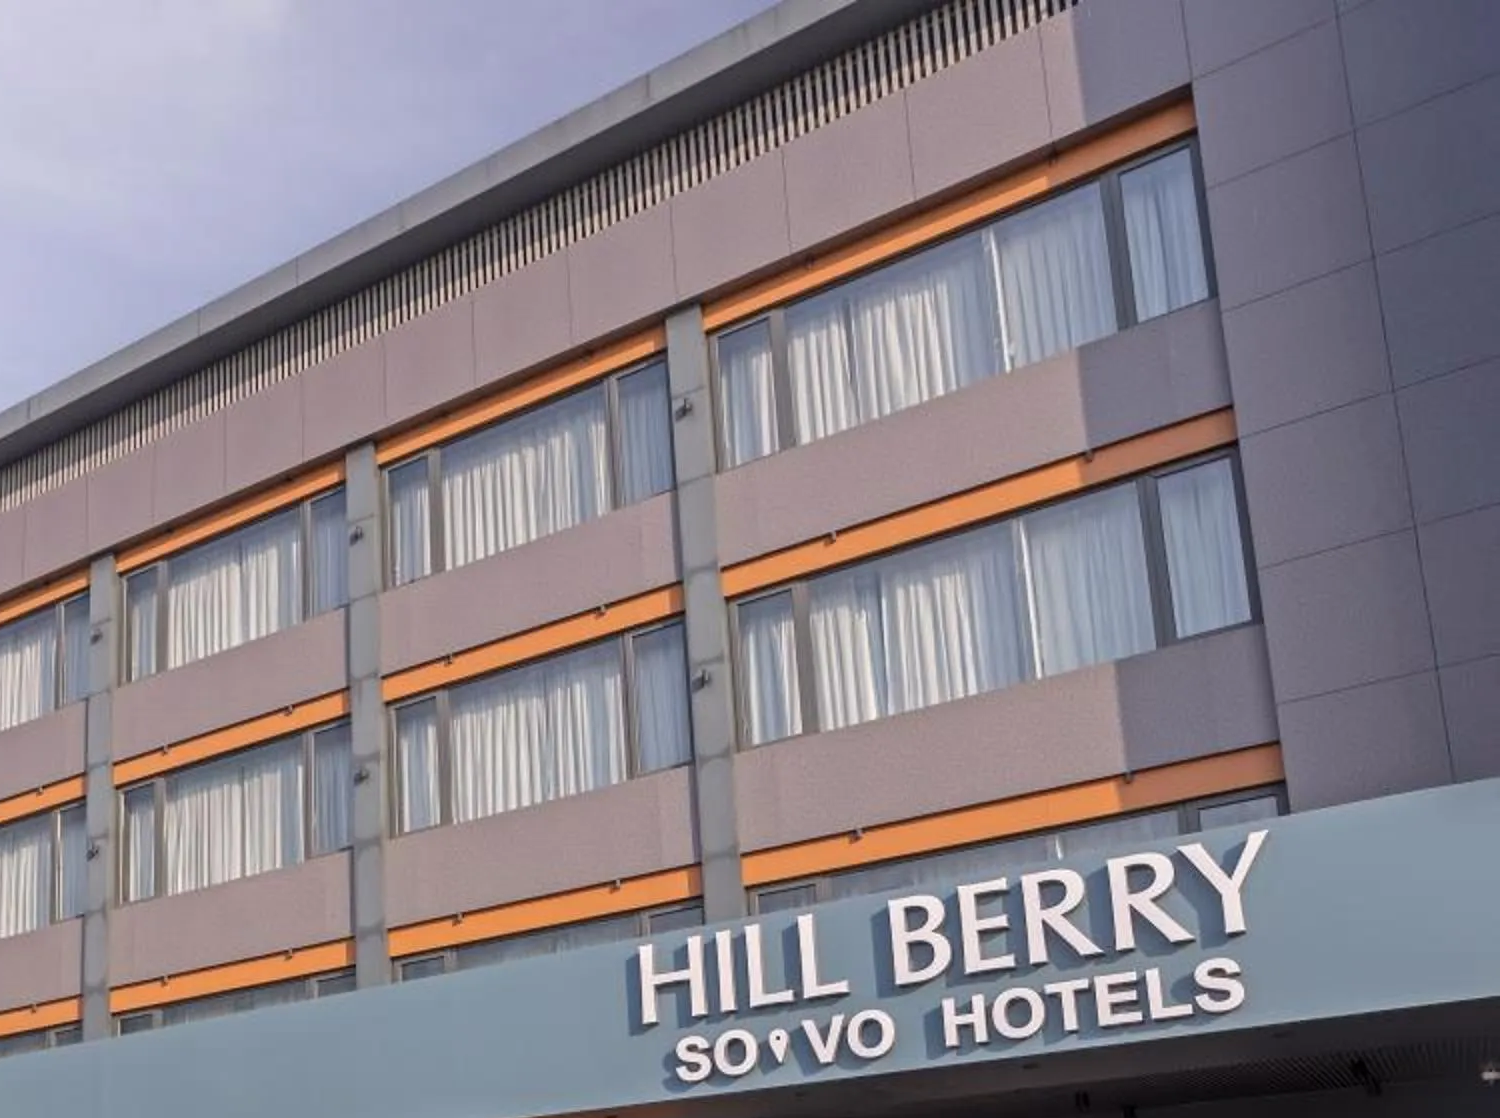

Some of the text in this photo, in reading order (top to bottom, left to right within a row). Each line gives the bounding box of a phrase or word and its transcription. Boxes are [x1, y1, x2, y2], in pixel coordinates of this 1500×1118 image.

[639, 829, 1269, 1025] HILL BERRY
[941, 957, 1246, 1048] HOTELS
